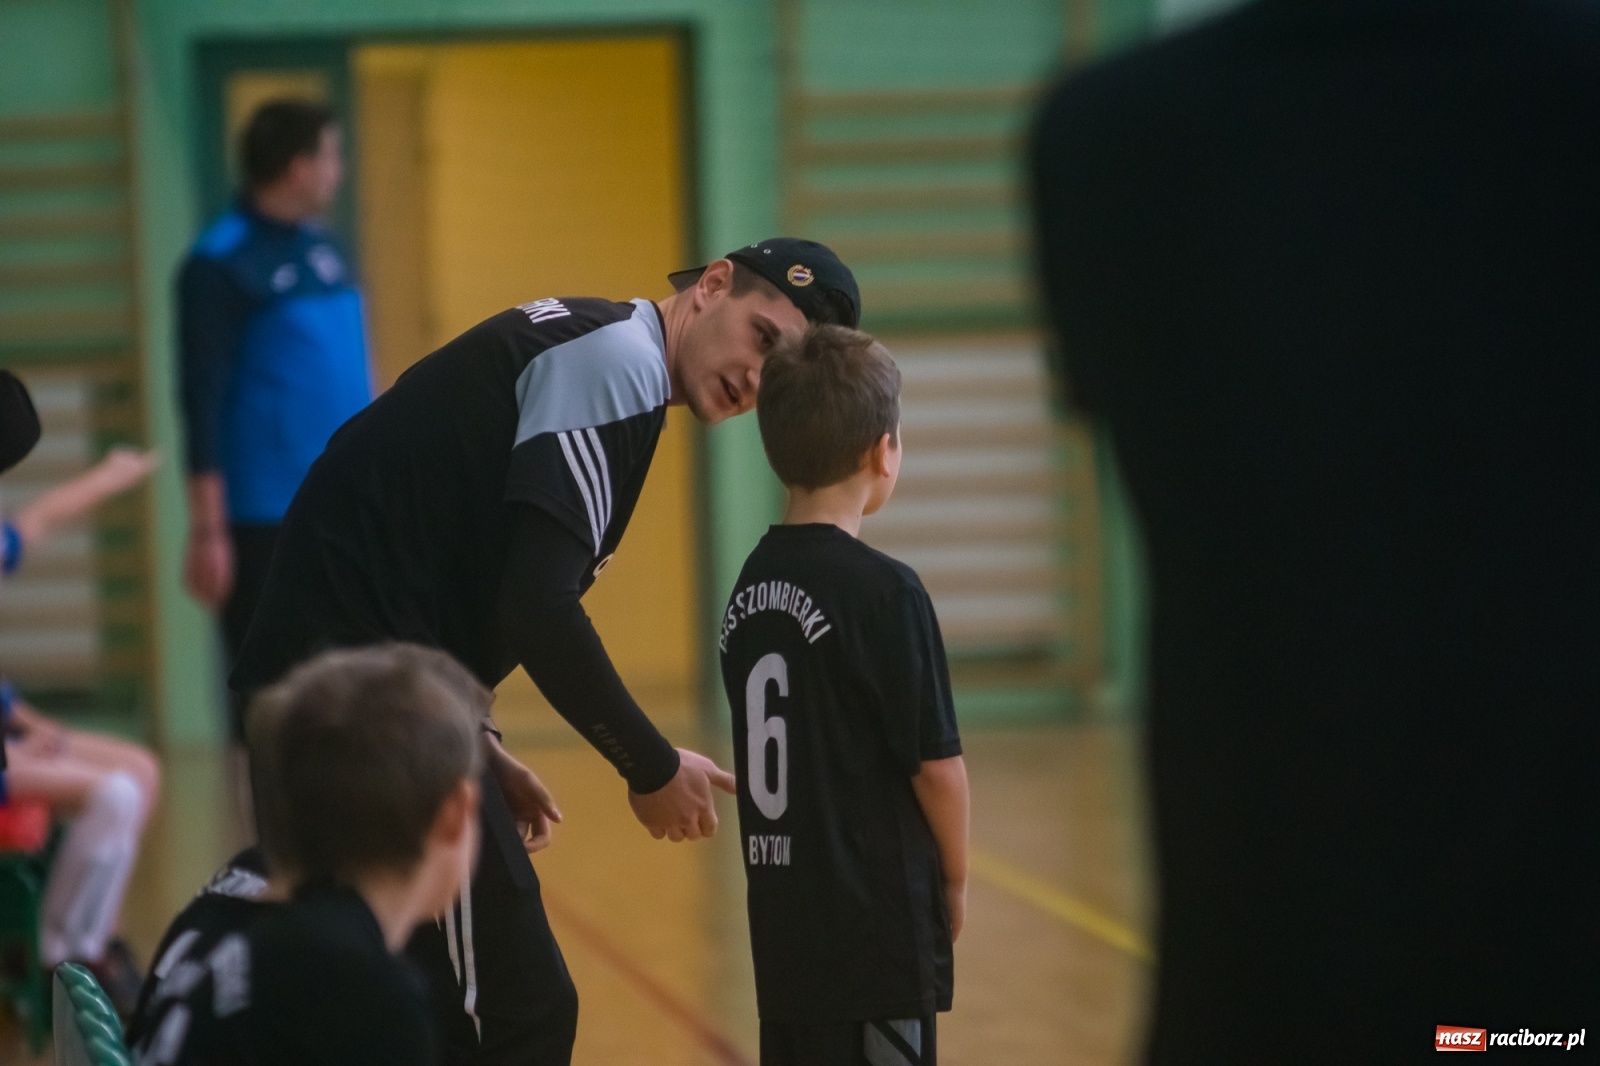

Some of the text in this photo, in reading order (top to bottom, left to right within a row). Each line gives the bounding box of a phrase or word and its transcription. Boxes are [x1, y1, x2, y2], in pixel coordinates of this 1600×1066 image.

[736, 581, 832, 645] SZOMBIERKI
[746, 652, 789, 821] 6
[749, 835, 791, 866] BYTOM
